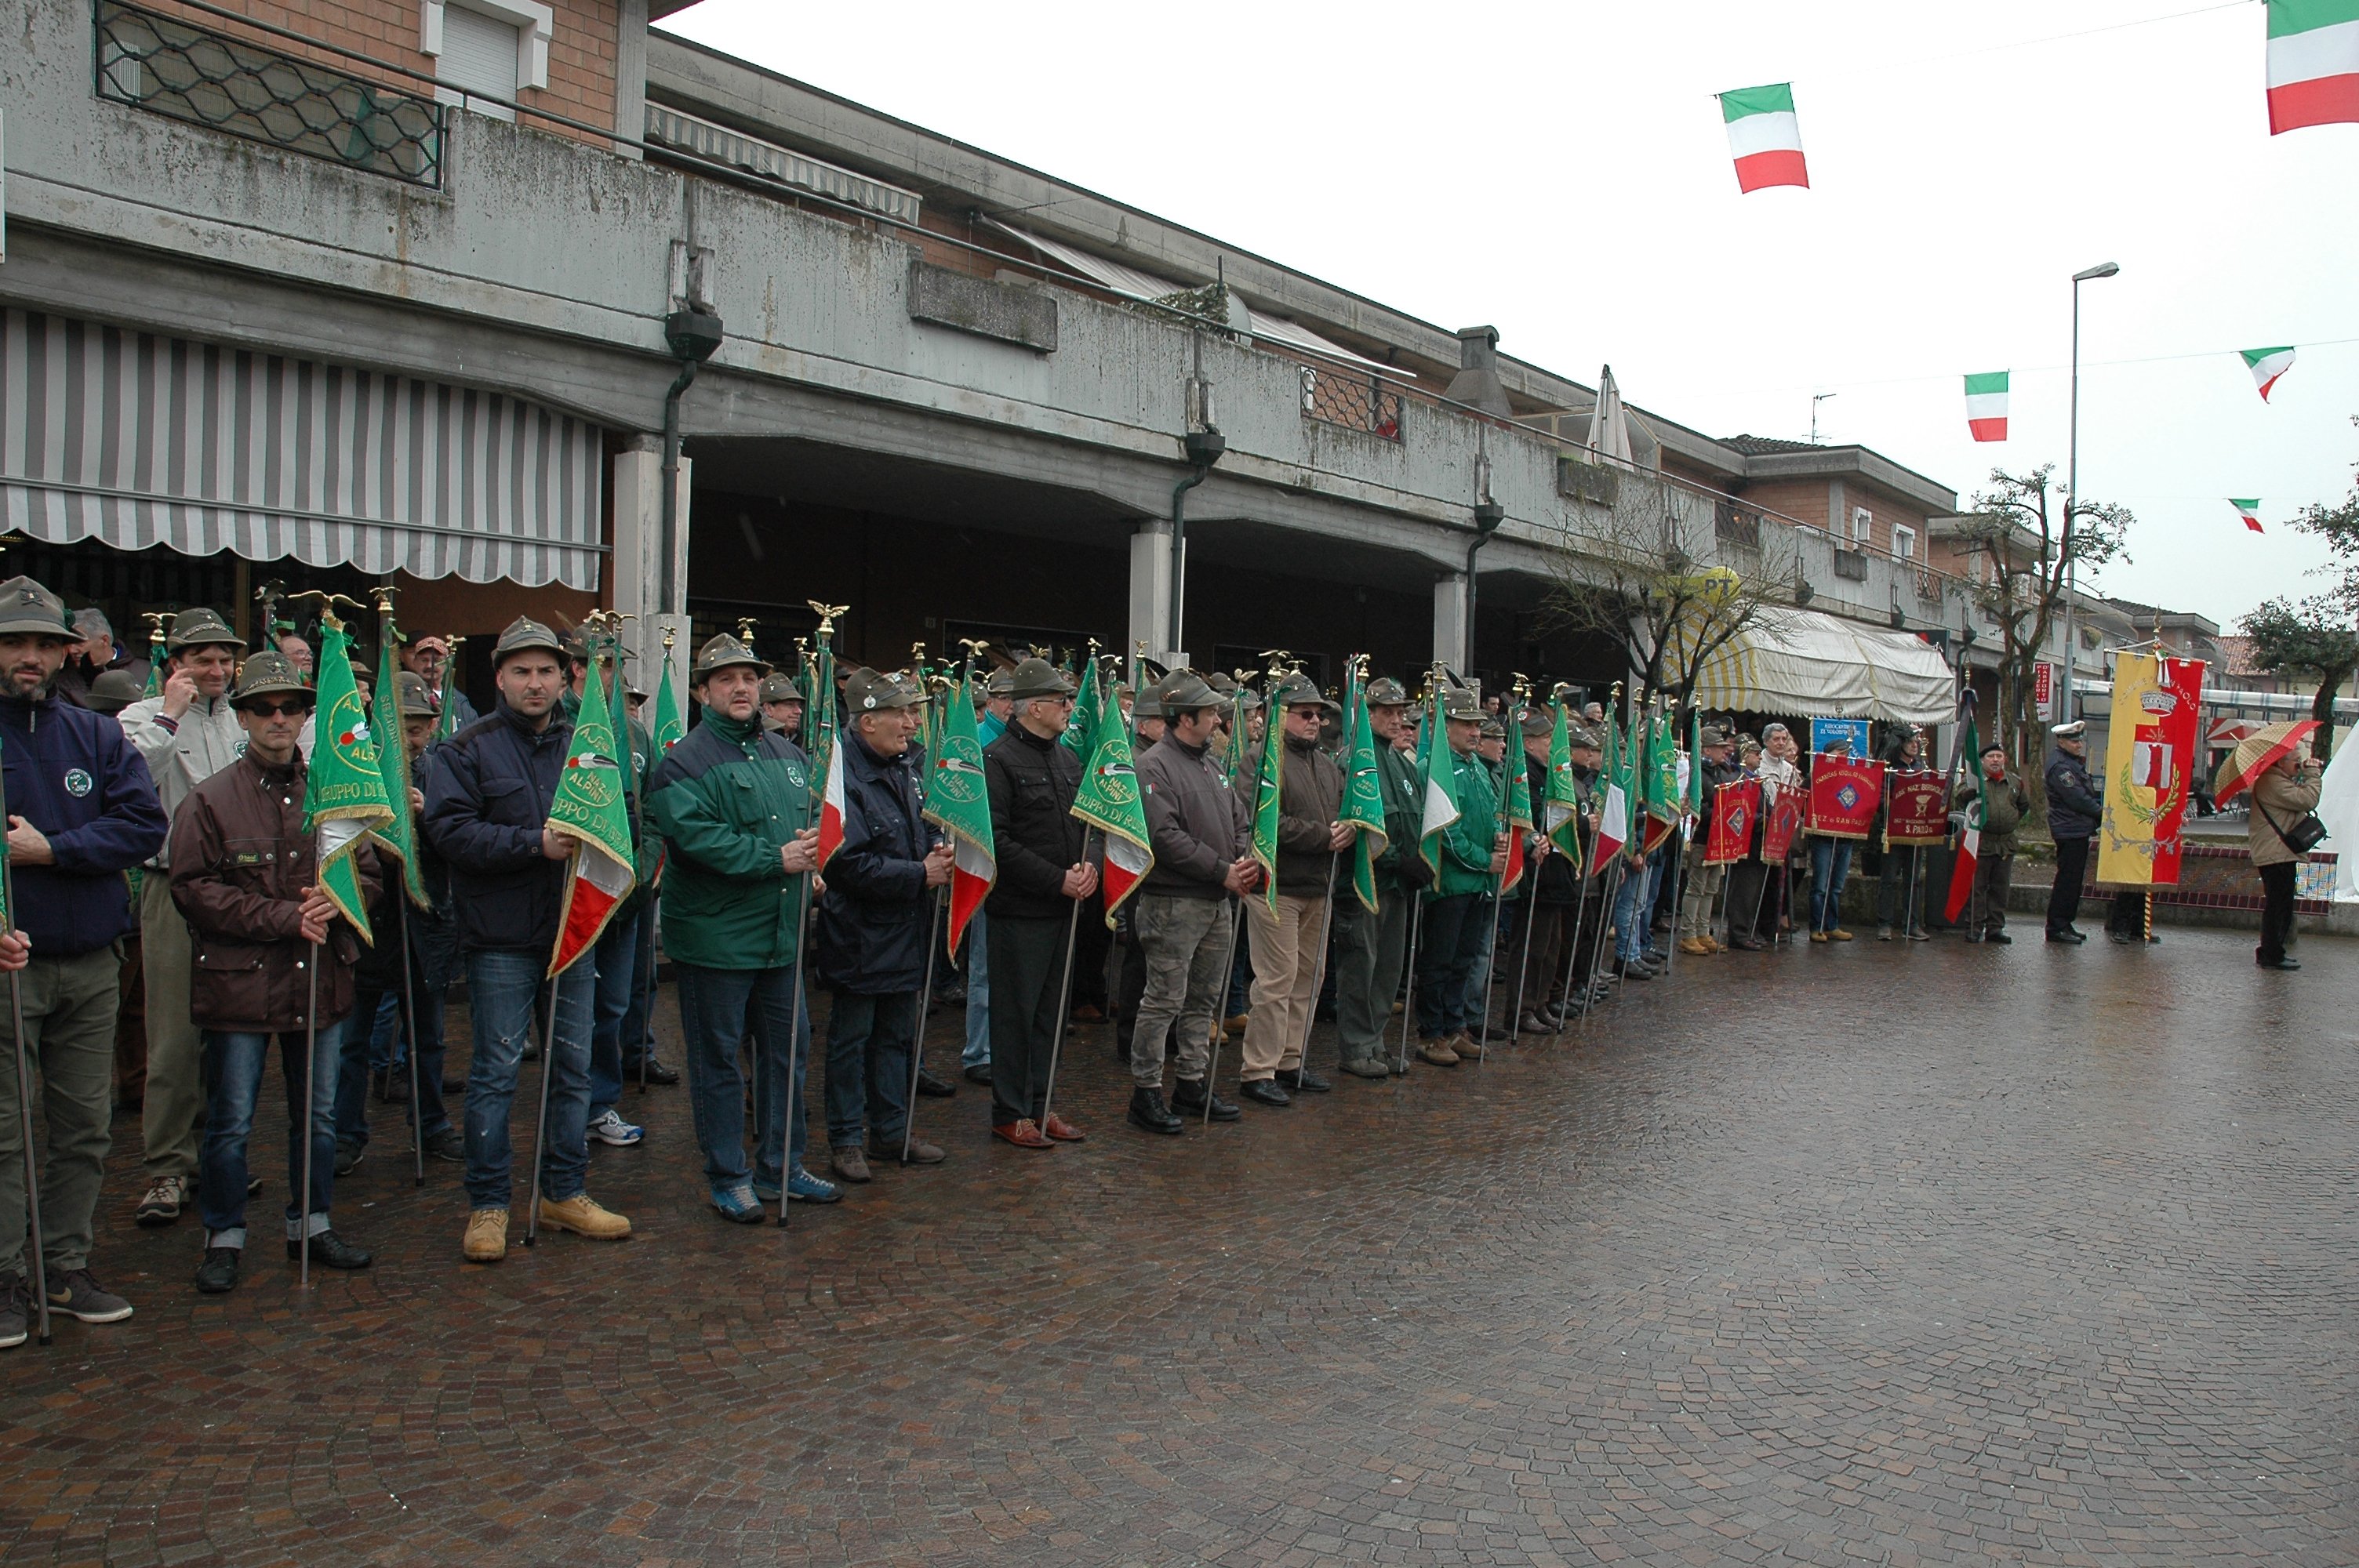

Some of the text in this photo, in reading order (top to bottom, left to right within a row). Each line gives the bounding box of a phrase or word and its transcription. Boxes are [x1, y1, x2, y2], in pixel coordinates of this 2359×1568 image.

[1704, 579, 1733, 596] PT
[569, 771, 603, 803] ALPINI
[936, 771, 964, 799] ALPINI
[1099, 778, 1122, 801] ALPINI
[593, 815, 609, 833] DI
